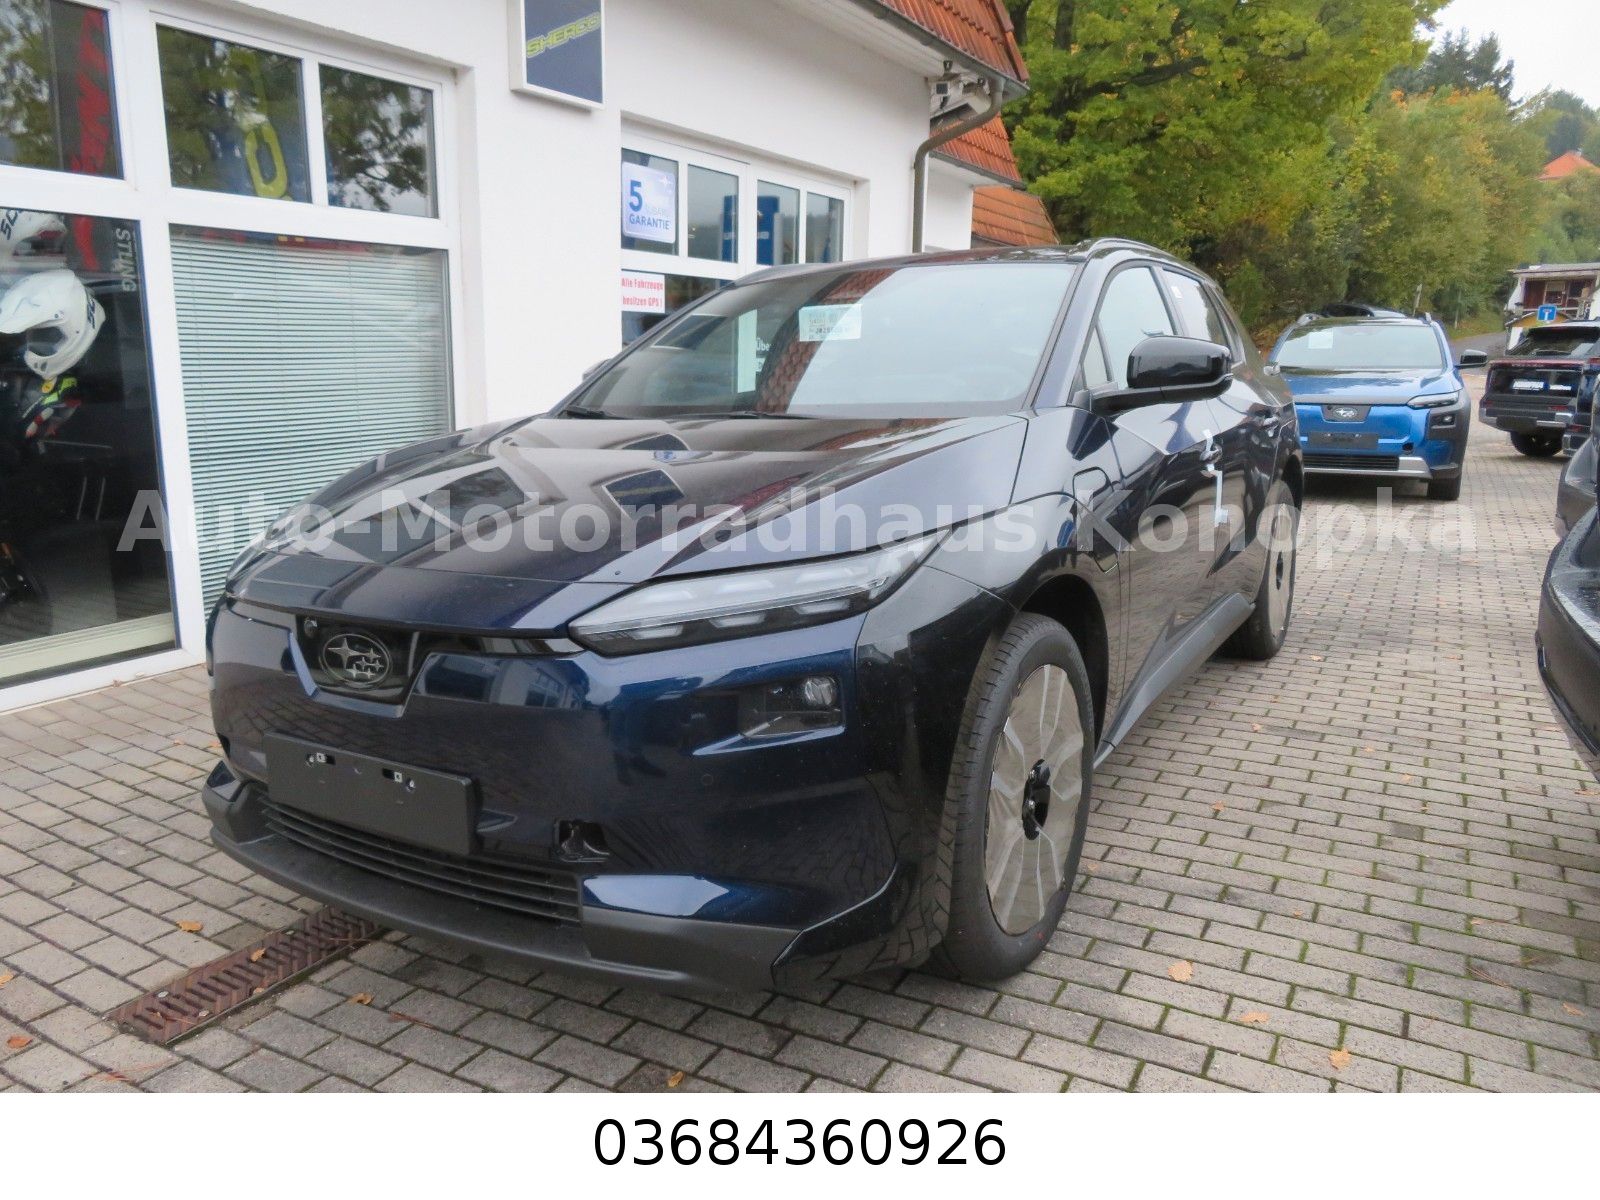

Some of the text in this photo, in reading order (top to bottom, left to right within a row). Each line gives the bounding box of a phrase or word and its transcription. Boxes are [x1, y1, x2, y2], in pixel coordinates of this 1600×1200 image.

[628, 180, 643, 213] 5
[629, 214, 670, 231] GARANTIE
[648, 297, 659, 307] GPS
